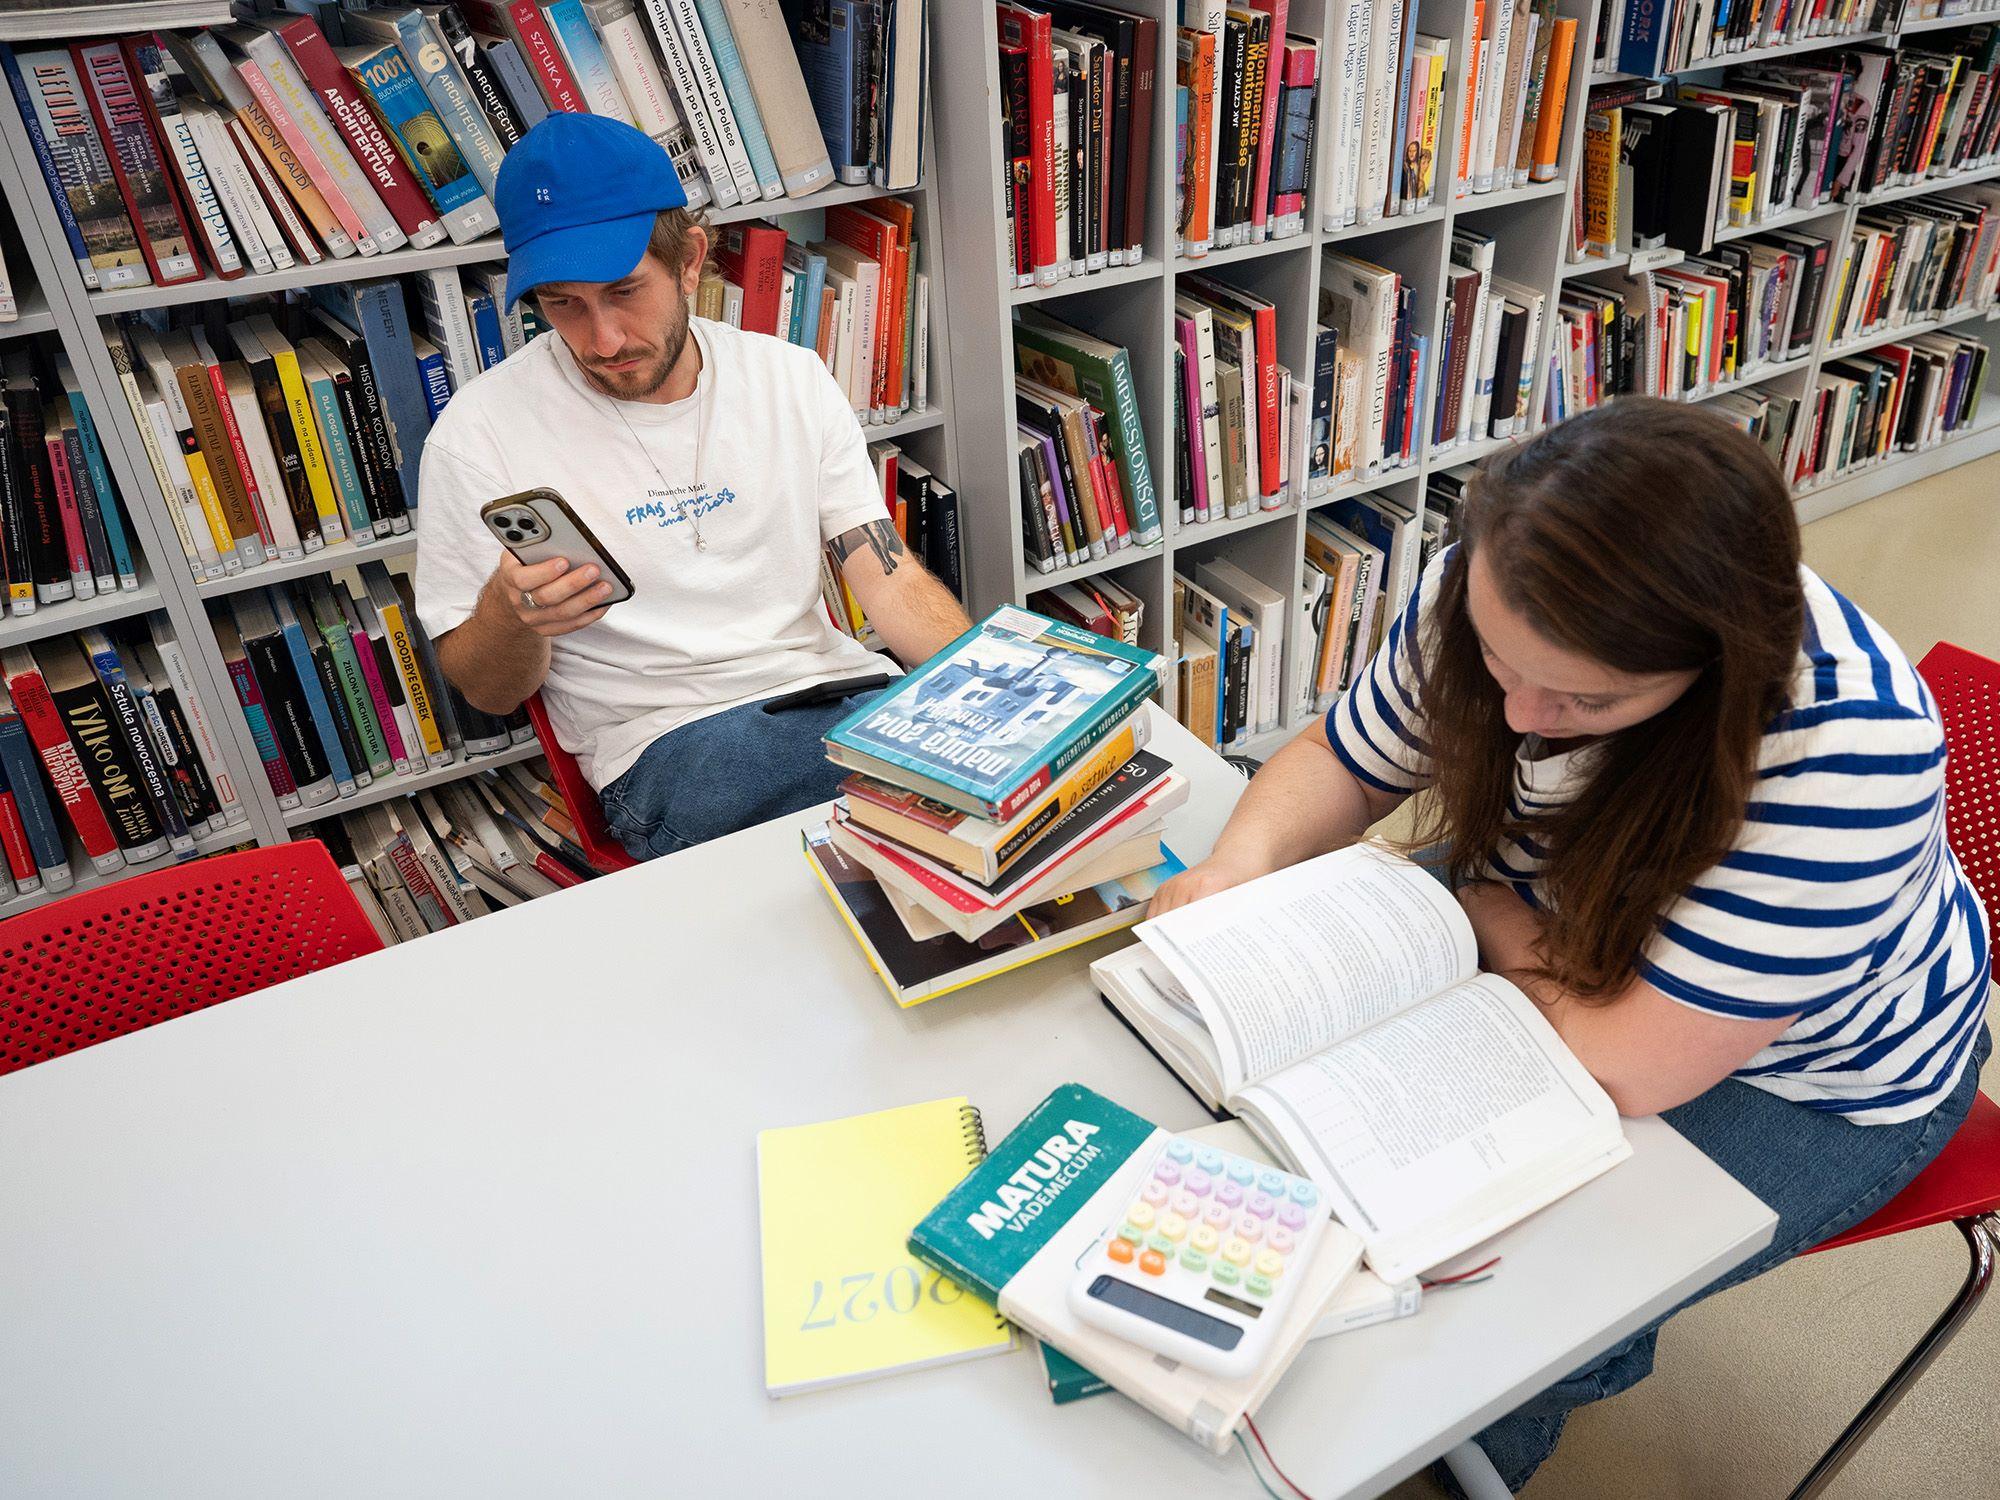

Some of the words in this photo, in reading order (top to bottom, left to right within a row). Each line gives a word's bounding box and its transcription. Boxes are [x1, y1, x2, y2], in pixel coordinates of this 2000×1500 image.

[1347, 3, 1360, 37] Edgar
[1472, 15, 1480, 37] Max
[1497, 25, 1510, 57] Monet
[365, 55, 407, 88] 1001
[417, 42, 447, 74] 6
[530, 31, 562, 89] SZTUKA
[1236, 33, 1246, 72] SZTUKĘ
[1345, 38, 1357, 79] Degas
[1387, 31, 1399, 74] Picasso
[1467, 39, 1478, 79] Doerner
[1536, 54, 1547, 90] GUSTAW
[249, 72, 288, 128] HAWAIKUM
[653, 0, 693, 93] rchiprzewodnik
[686, 93, 699, 112] po
[694, 111, 717, 157] Europie
[1093, 55, 1103, 108] Salvador
[1119, 57, 1129, 100] Beksiński
[1233, 73, 1243, 113] CZYTAĆ
[1250, 41, 1269, 147] Montmartre
[1400, 68, 1411, 129] Impresjonizm
[1502, 61, 1519, 132] REMBRANDT
[438, 74, 492, 163] ARCHITECTURE
[709, 90, 723, 109] po
[718, 108, 736, 148] Polsce
[1012, 61, 1028, 150] SKARBY
[1091, 108, 1102, 134] Dalí
[1232, 113, 1240, 128] JAK
[1238, 43, 1260, 167] Montparnasse
[1268, 96, 1278, 133] CHAGALL
[1353, 92, 1365, 129] Renoir
[1532, 89, 1542, 119] KLIMT
[134, 135, 147, 160] Beata
[244, 101, 282, 151] ANTONI
[324, 87, 398, 190] ARCHITEKTURY
[348, 97, 397, 167] HISTORIA
[1369, 88, 1382, 181] NOWOSIELSKI
[28, 118, 56, 176] BUDOWNICTWO
[50, 176, 77, 228] EKOLOGICZNE
[78, 146, 92, 173] Beata
[1062, 148, 1070, 212] HISTORIA
[1484, 268, 1492, 284] Paul
[377, 290, 397, 339] NEUFERT
[784, 299, 792, 326] SMART
[168, 379, 177, 398] Charles
[173, 397, 183, 414] Landry
[321, 395, 331, 411] DLA
[427, 366, 452, 406] MIASTA
[1265, 364, 1275, 409] BOSCH
[1372, 349, 1388, 431] BRUEGEL
[294, 398, 309, 425] Miasto
[302, 424, 309, 435] na
[326, 411, 341, 438] KOGO
[358, 364, 378, 415] HISTORIA
[371, 416, 393, 470] KOLORÓW
[187, 374, 206, 419] ELEMENTY
[204, 422, 222, 452] DETALE
[214, 455, 246, 525] ARCHITEKTONICZNE
[220, 395, 240, 438] PROJEKTOWANIE
[234, 439, 254, 489] ARCHITEKTONICZNE
[304, 434, 318, 469] żądanie
[333, 436, 346, 459] JEST
[344, 390, 360, 431] ARCHITEKTURA
[365, 462, 377, 496] RENESANSU
[1061, 439, 1069, 467] Testament
[1113, 360, 1155, 523] IMPRESJONIŚCI
[30, 464, 41, 500] Pomian
[69, 436, 81, 465] Potocka
[77, 469, 87, 490] Nowa
[83, 489, 94, 520] estetyka
[339, 457, 355, 493] MIASTO?
[647, 486, 687, 498] Dimanche
[34, 500, 51, 545] Krzysztof
[626, 501, 667, 525] FRAIS
[1353, 560, 1371, 622] Modigliani
[171, 653, 184, 678] Ulysses
[323, 661, 330, 669] 50
[326, 668, 336, 691] teorii
[394, 630, 419, 685] GOODBYE
[410, 684, 431, 721] GIEREK
[1192, 658, 1216, 677] 1001
[331, 690, 350, 732] architektury
[342, 659, 359, 696] ZIELONA
[355, 696, 380, 756] ARCHITEKTURA
[370, 678, 399, 747] ARCHITEKTURA
[68, 696, 114, 762] TYLKO
[102, 765, 137, 805] ONE
[111, 683, 134, 726] Sztuka
[128, 726, 165, 798] nowoczesna
[145, 700, 162, 728] ARTYŚCI
[154, 726, 176, 764] UDRĘCZENI
[284, 700, 295, 723] Historia
[292, 722, 307, 754] architektury
[303, 752, 319, 778] zachodniej
[866, 713, 924, 746] 2014
[41, 747, 81, 806] NIEPOSPOLITE
[60, 741, 91, 790] RZECZY
[1122, 762, 1148, 779] 50
[131, 802, 153, 838] SYLWIA
[999, 828, 1026, 860] BOŻENA
[391, 845, 431, 899] CZERWONY
[429, 855, 448, 885] GALERIA
[444, 879, 464, 908] AUTORSKA
[966, 1119, 1101, 1241] MATURA
[1005, 1143, 1102, 1234] VADEMECUM
